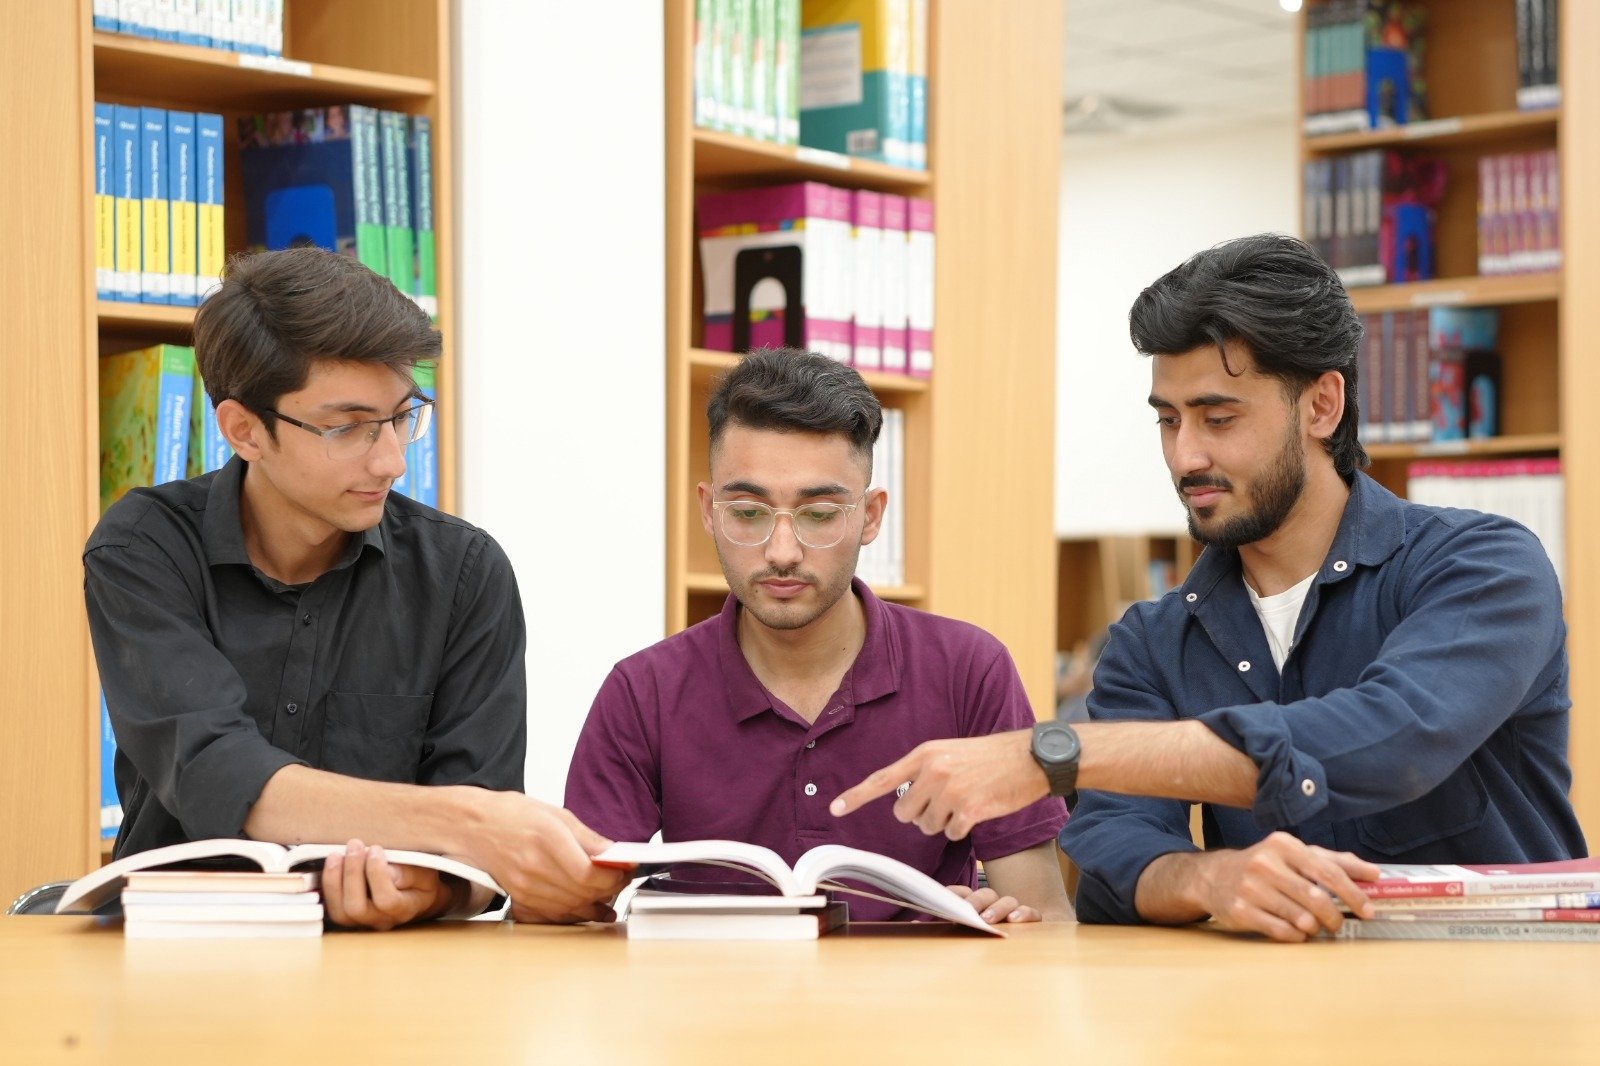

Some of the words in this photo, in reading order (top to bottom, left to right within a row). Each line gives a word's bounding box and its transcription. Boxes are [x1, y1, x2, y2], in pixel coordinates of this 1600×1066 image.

[1489, 883, 1514, 891] System
[1516, 882, 1544, 890] Analysis
[1546, 881, 1559, 889] and
[1448, 925, 1500, 936] VIRUSES
[1502, 925, 1519, 935] PC
